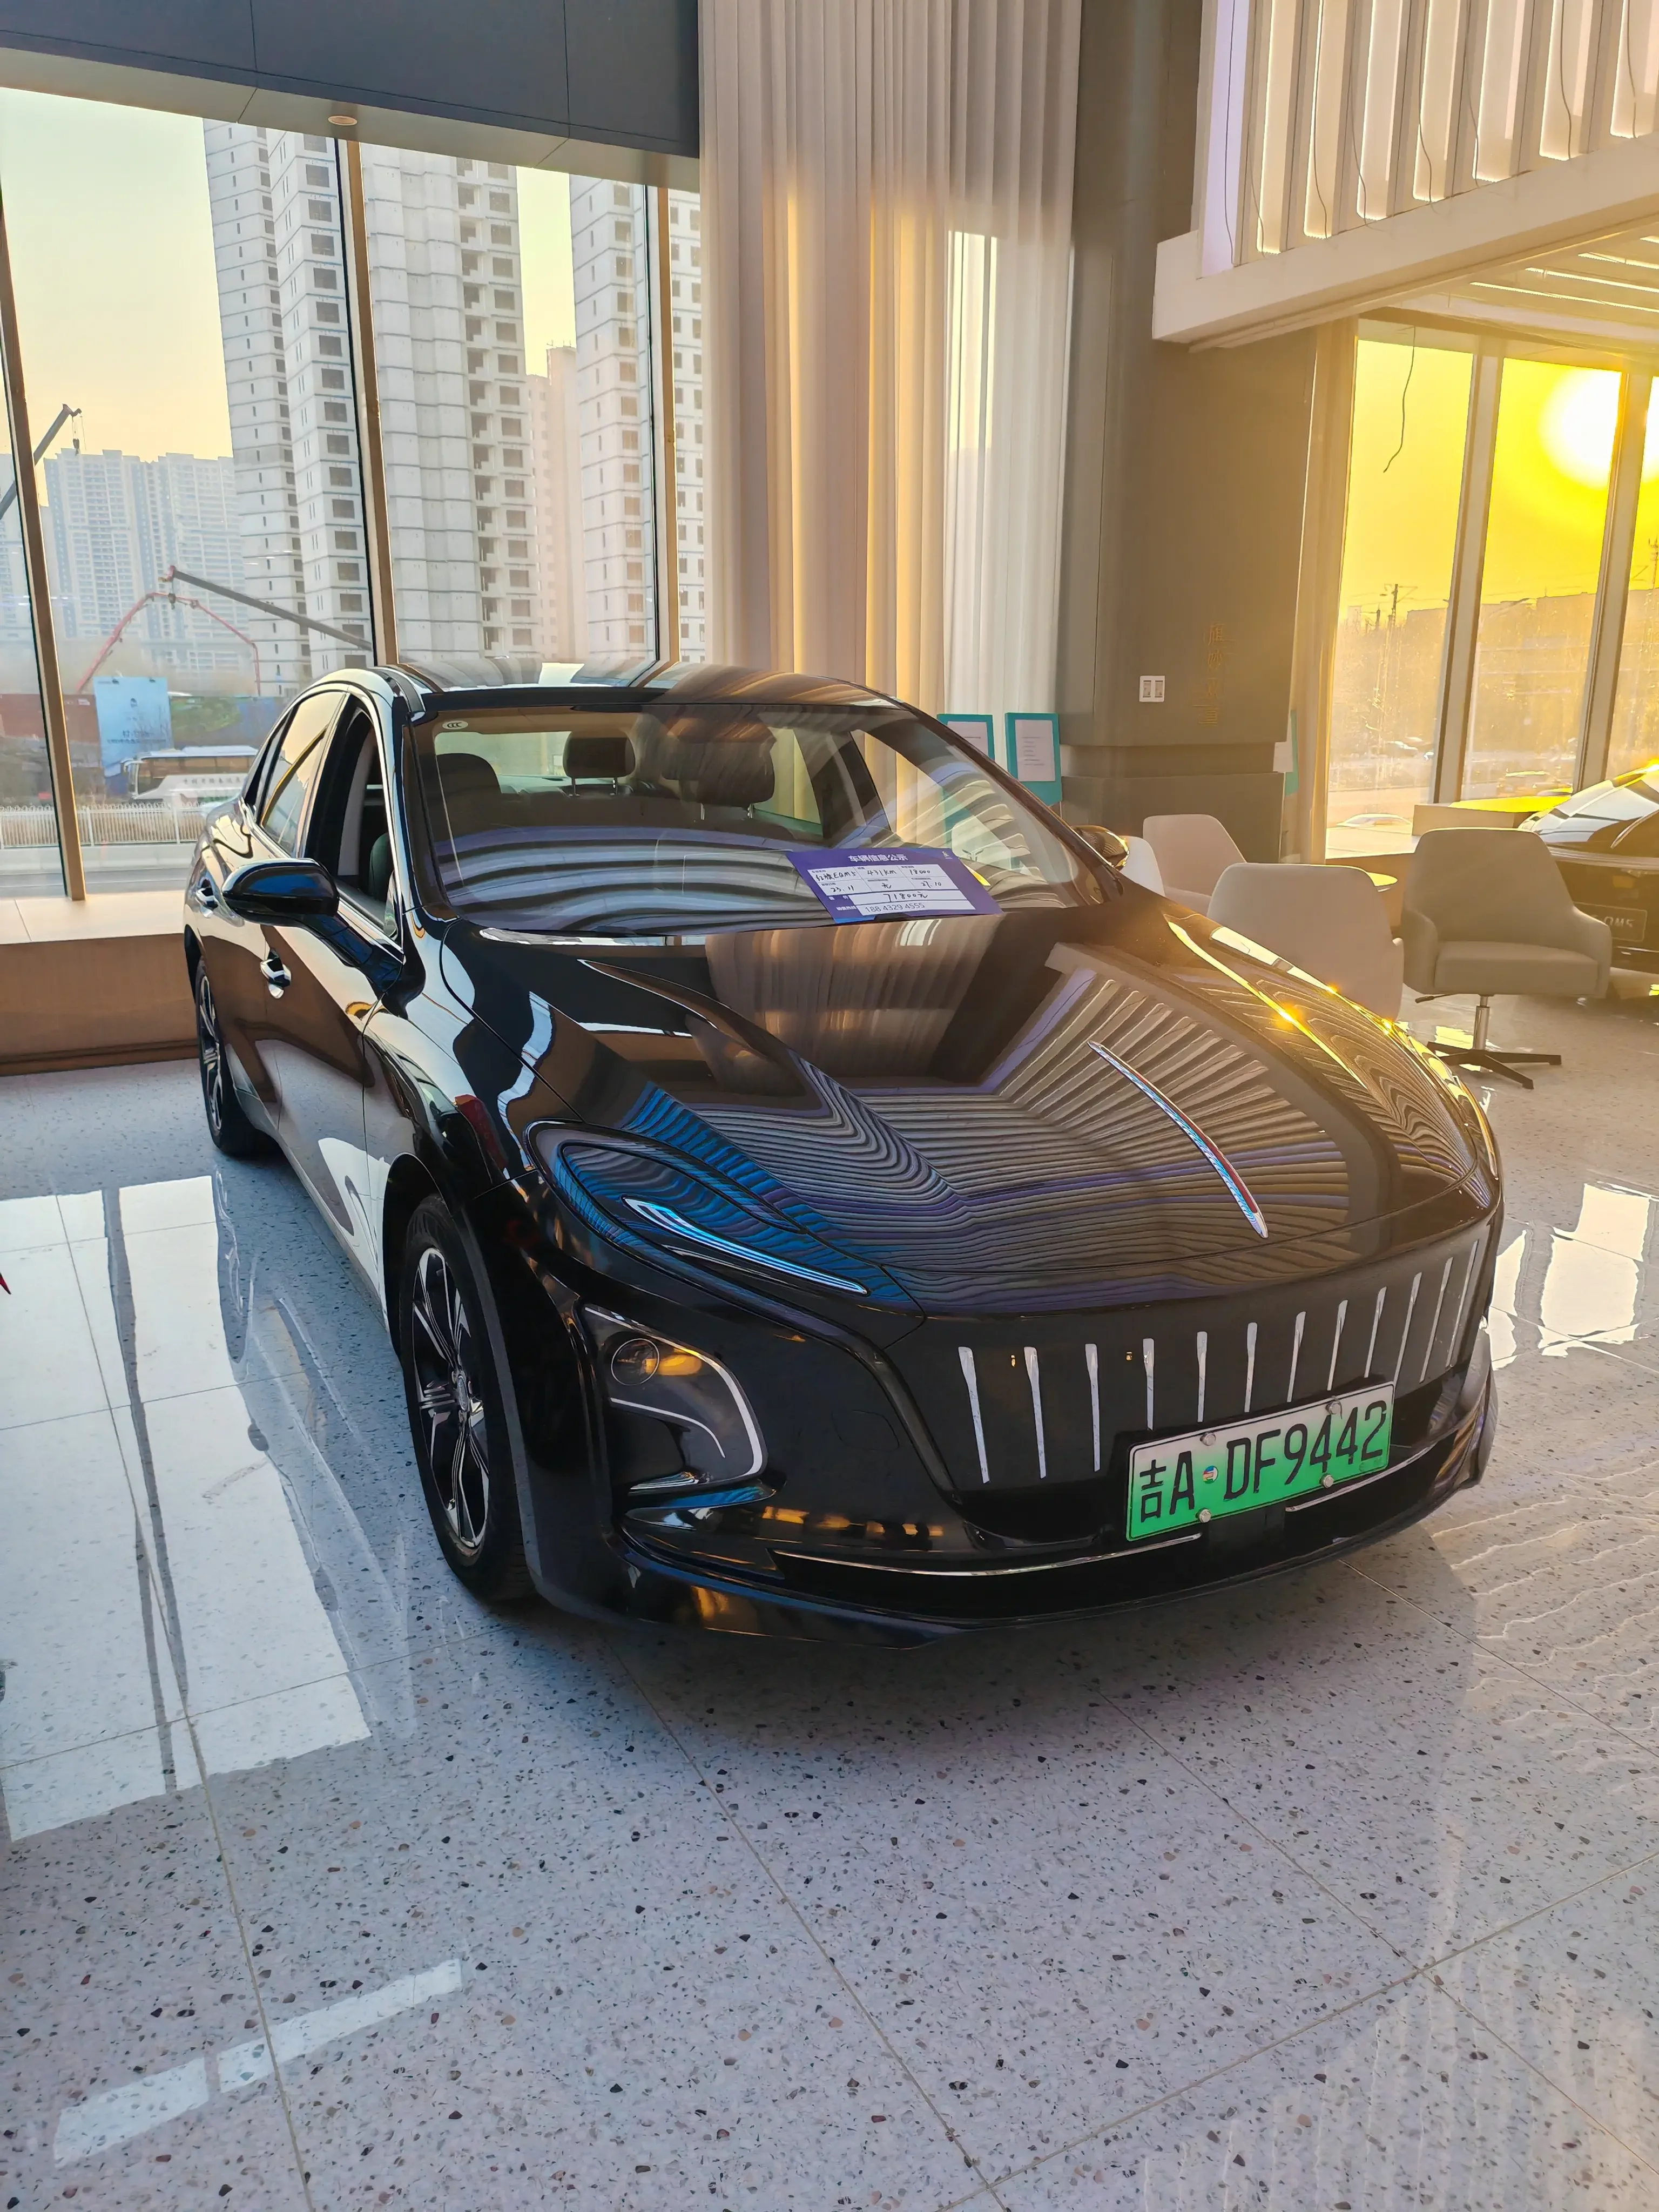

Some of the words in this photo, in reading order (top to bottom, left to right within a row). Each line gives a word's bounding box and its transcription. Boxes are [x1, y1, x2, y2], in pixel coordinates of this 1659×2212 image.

[848, 853, 909, 863] 车辆信息公示
